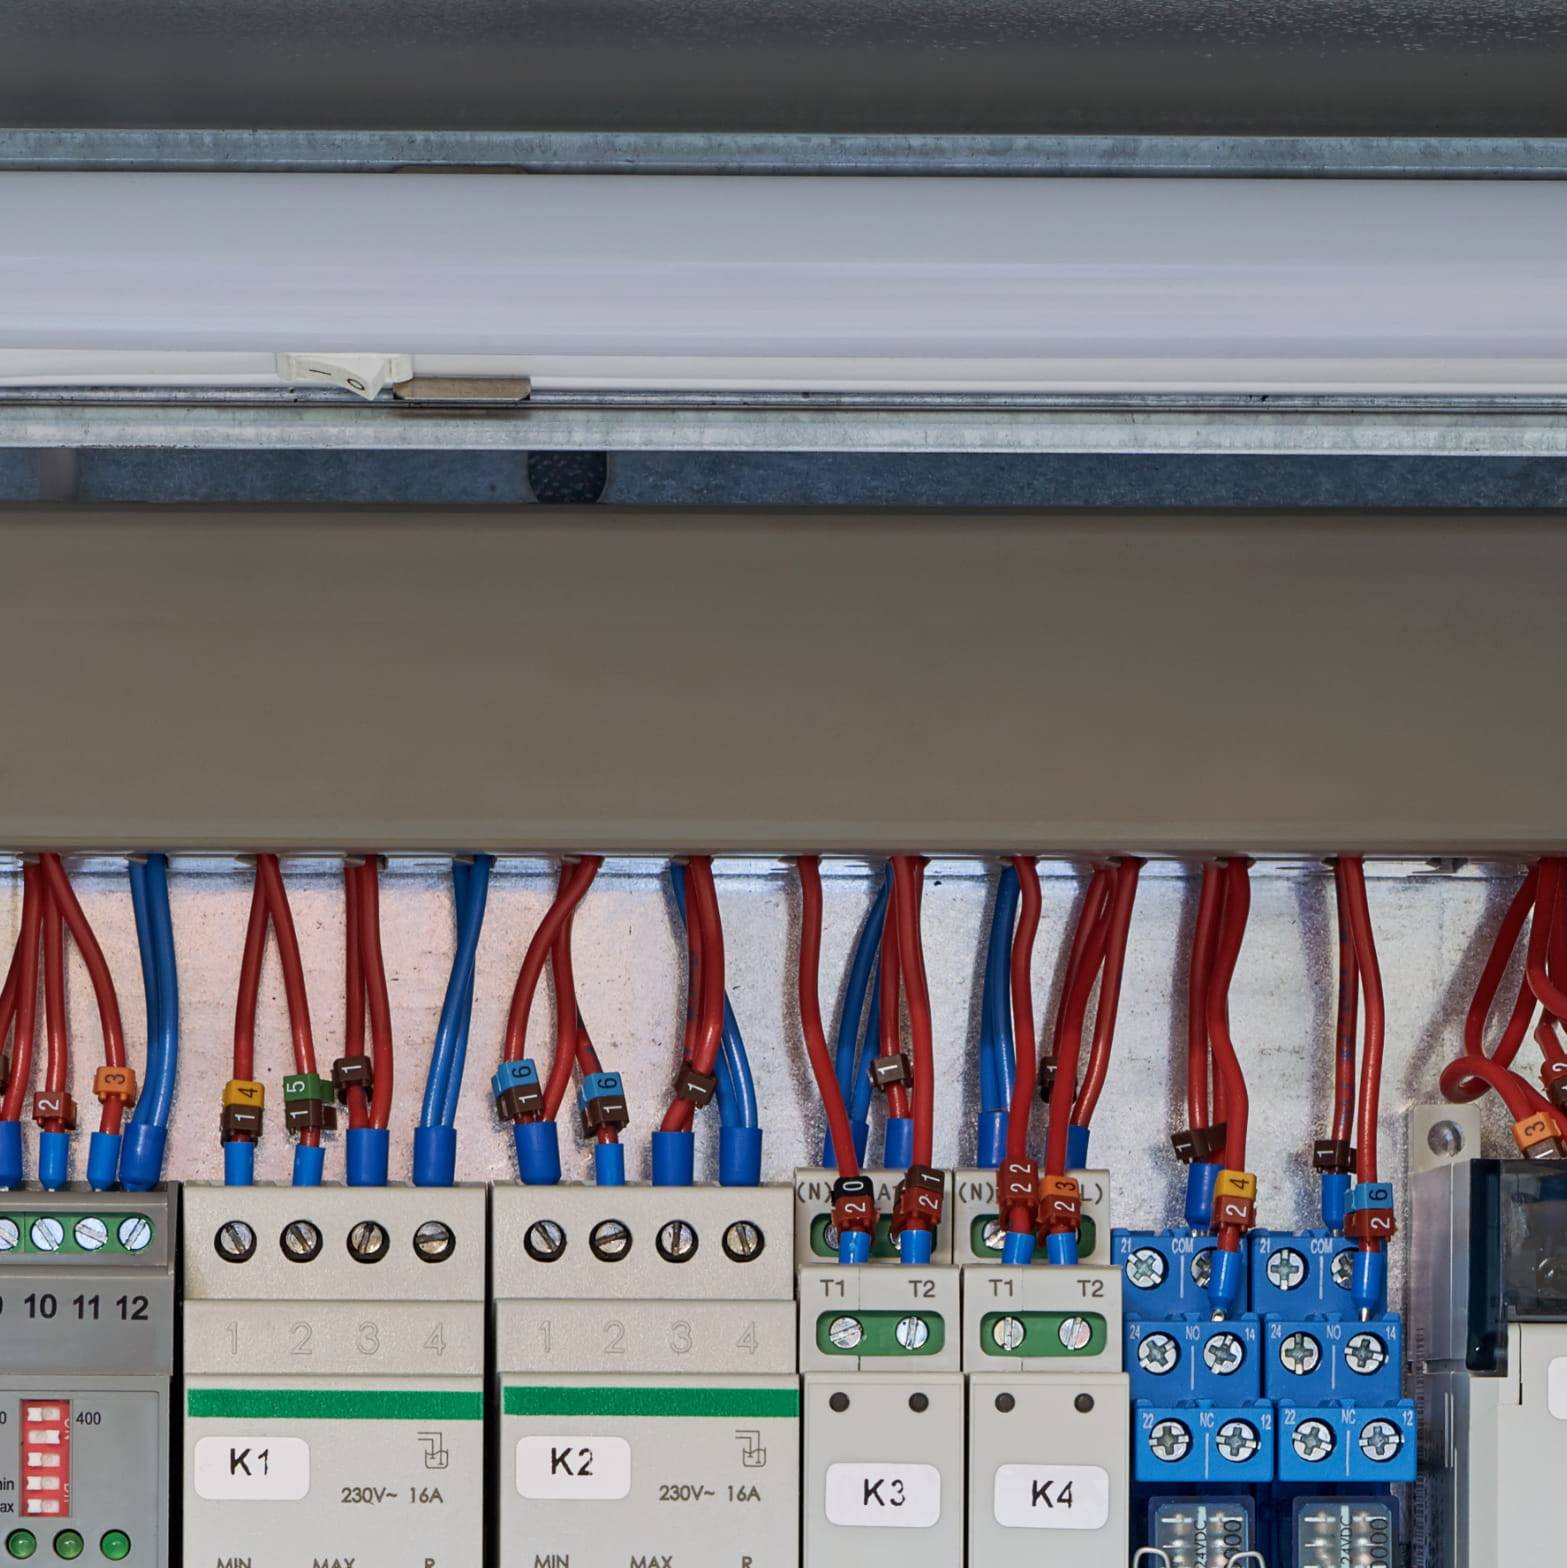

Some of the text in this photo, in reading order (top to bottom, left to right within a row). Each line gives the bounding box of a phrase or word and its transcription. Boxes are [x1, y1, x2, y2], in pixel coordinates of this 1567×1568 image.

[820, 1280, 845, 1297] T1
[909, 1280, 935, 1298] T2
[989, 1280, 1014, 1297] T1
[1078, 1280, 1104, 1298] T2
[25, 1294, 57, 1319] 10
[73, 1294, 99, 1320] 11
[117, 1295, 149, 1320] 12
[76, 1412, 101, 1425] 400
[230, 1448, 269, 1476] K1
[550, 1447, 593, 1476] K2
[864, 1479, 906, 1507] K3
[1031, 1480, 1073, 1508] K4
